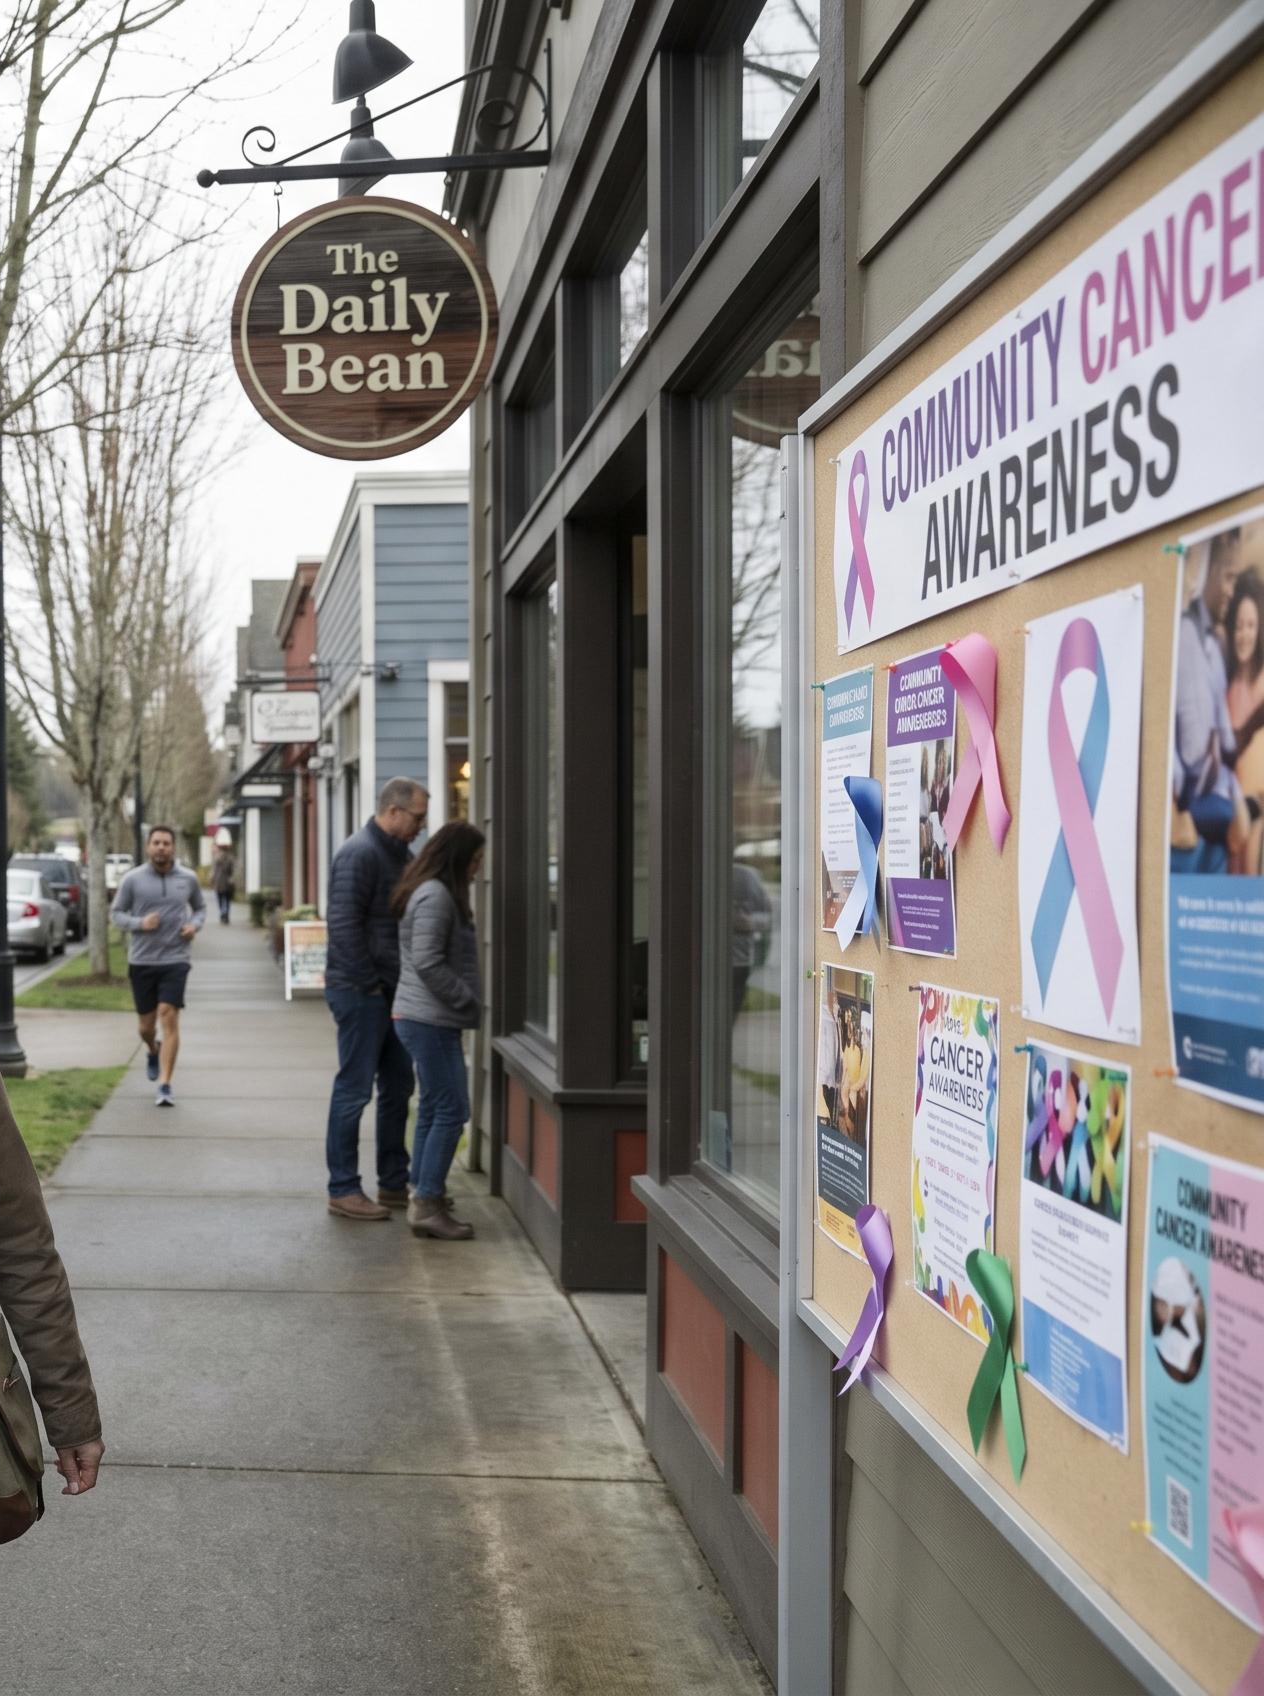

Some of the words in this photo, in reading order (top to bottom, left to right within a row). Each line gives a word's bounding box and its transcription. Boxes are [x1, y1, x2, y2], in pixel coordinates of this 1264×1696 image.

[326, 243, 399, 275] The
[279, 277, 450, 346] Daily
[281, 342, 449, 394] Bean
[881, 296, 1066, 512] COMMUNITY
[921, 362, 1180, 600] AWARENESS
[930, 1036, 984, 1082] CANCER
[929, 1071, 984, 1112] AWARENESS
[1155, 1206, 1197, 1252] CANCER
[1176, 1176, 1249, 1232] COMMUNITY
